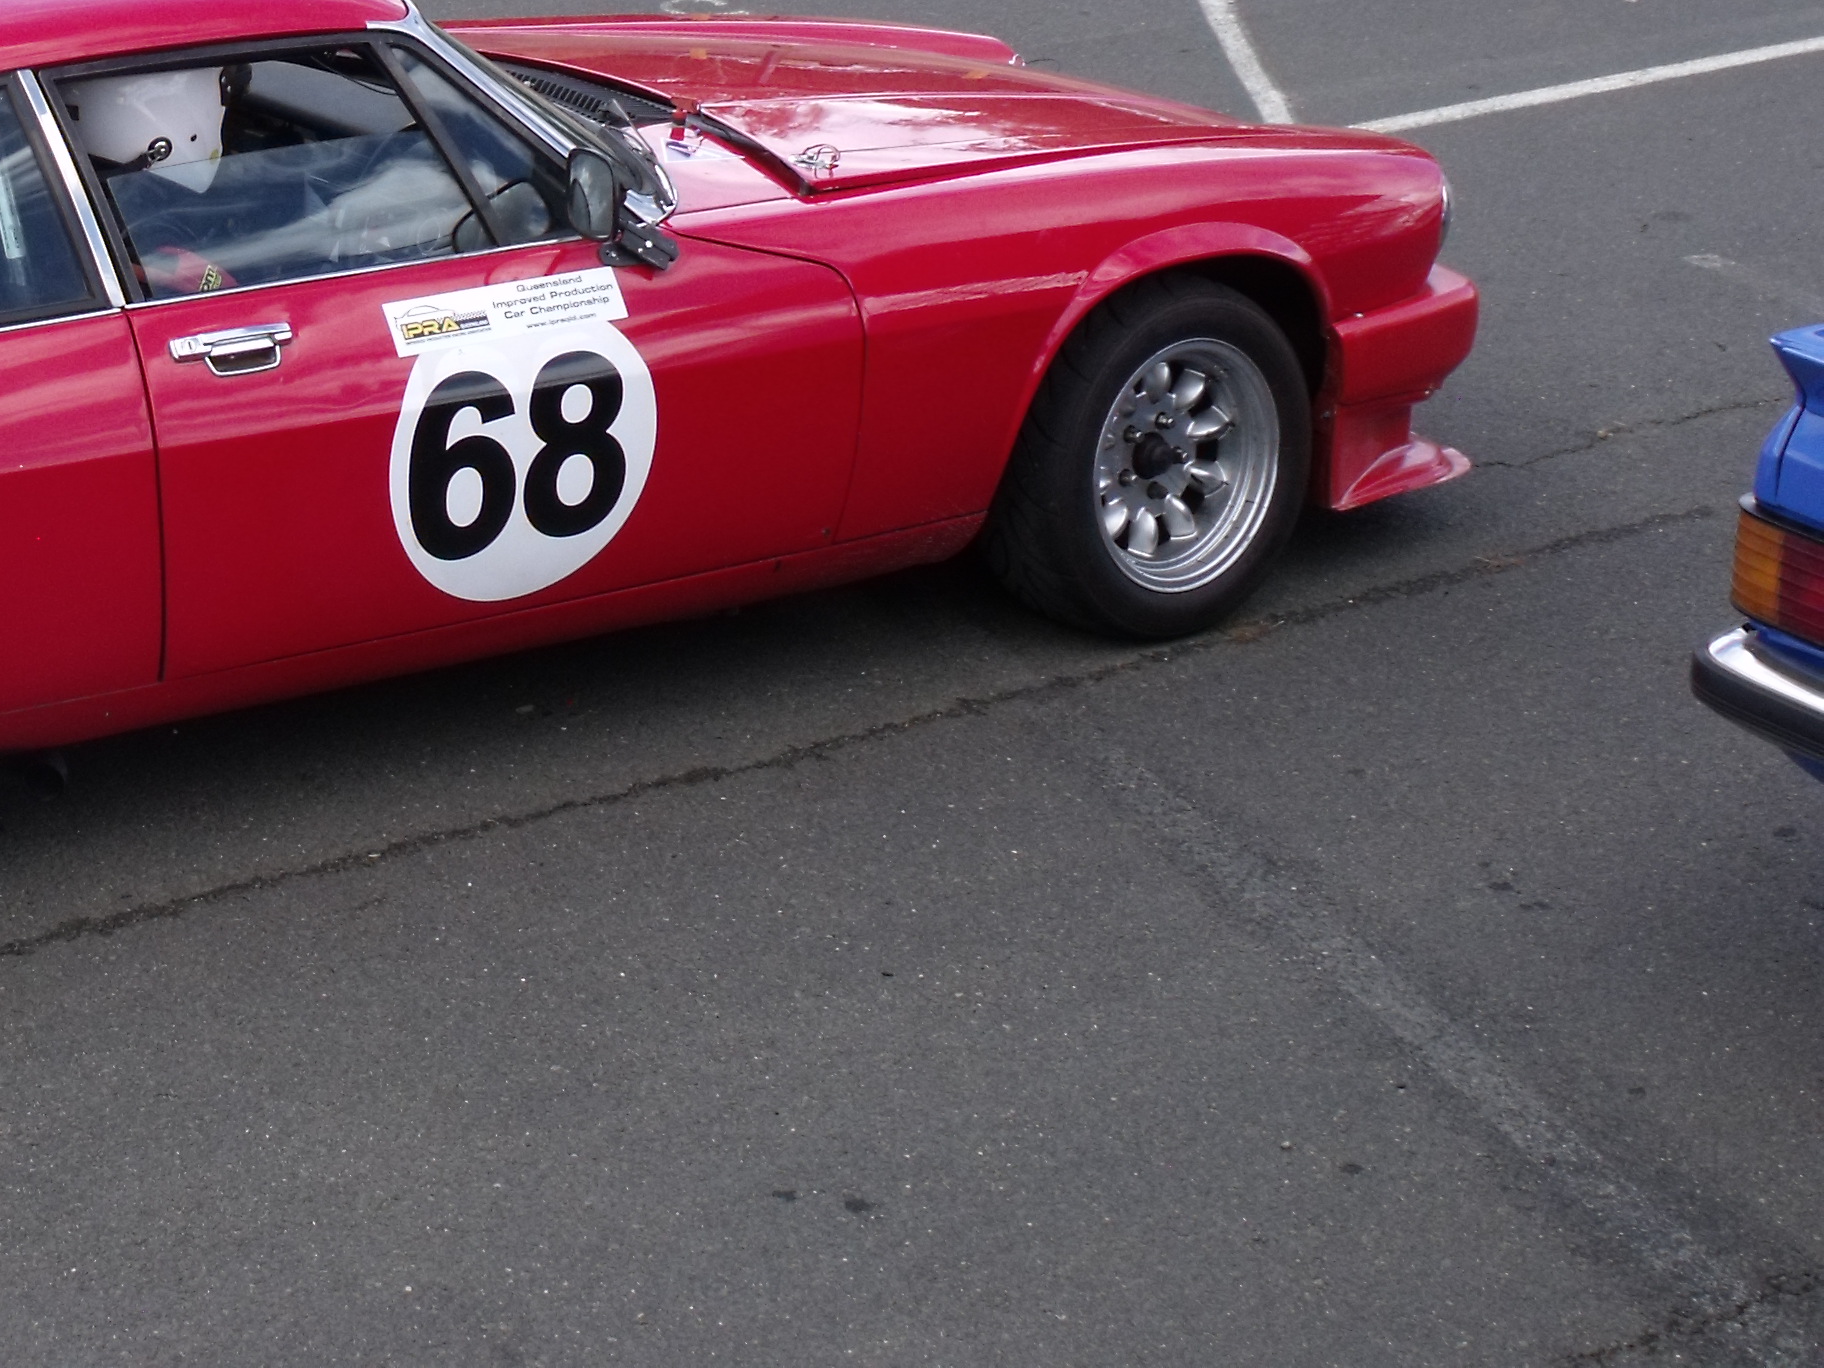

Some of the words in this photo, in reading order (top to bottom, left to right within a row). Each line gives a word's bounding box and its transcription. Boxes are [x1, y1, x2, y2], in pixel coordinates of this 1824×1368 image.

[492, 293, 546, 309] Improved
[550, 282, 613, 299] Production
[516, 275, 582, 292] Queensland
[504, 308, 525, 319] Car
[530, 295, 610, 316] Championship
[401, 316, 460, 340] IPRA
[409, 350, 627, 561] 68
